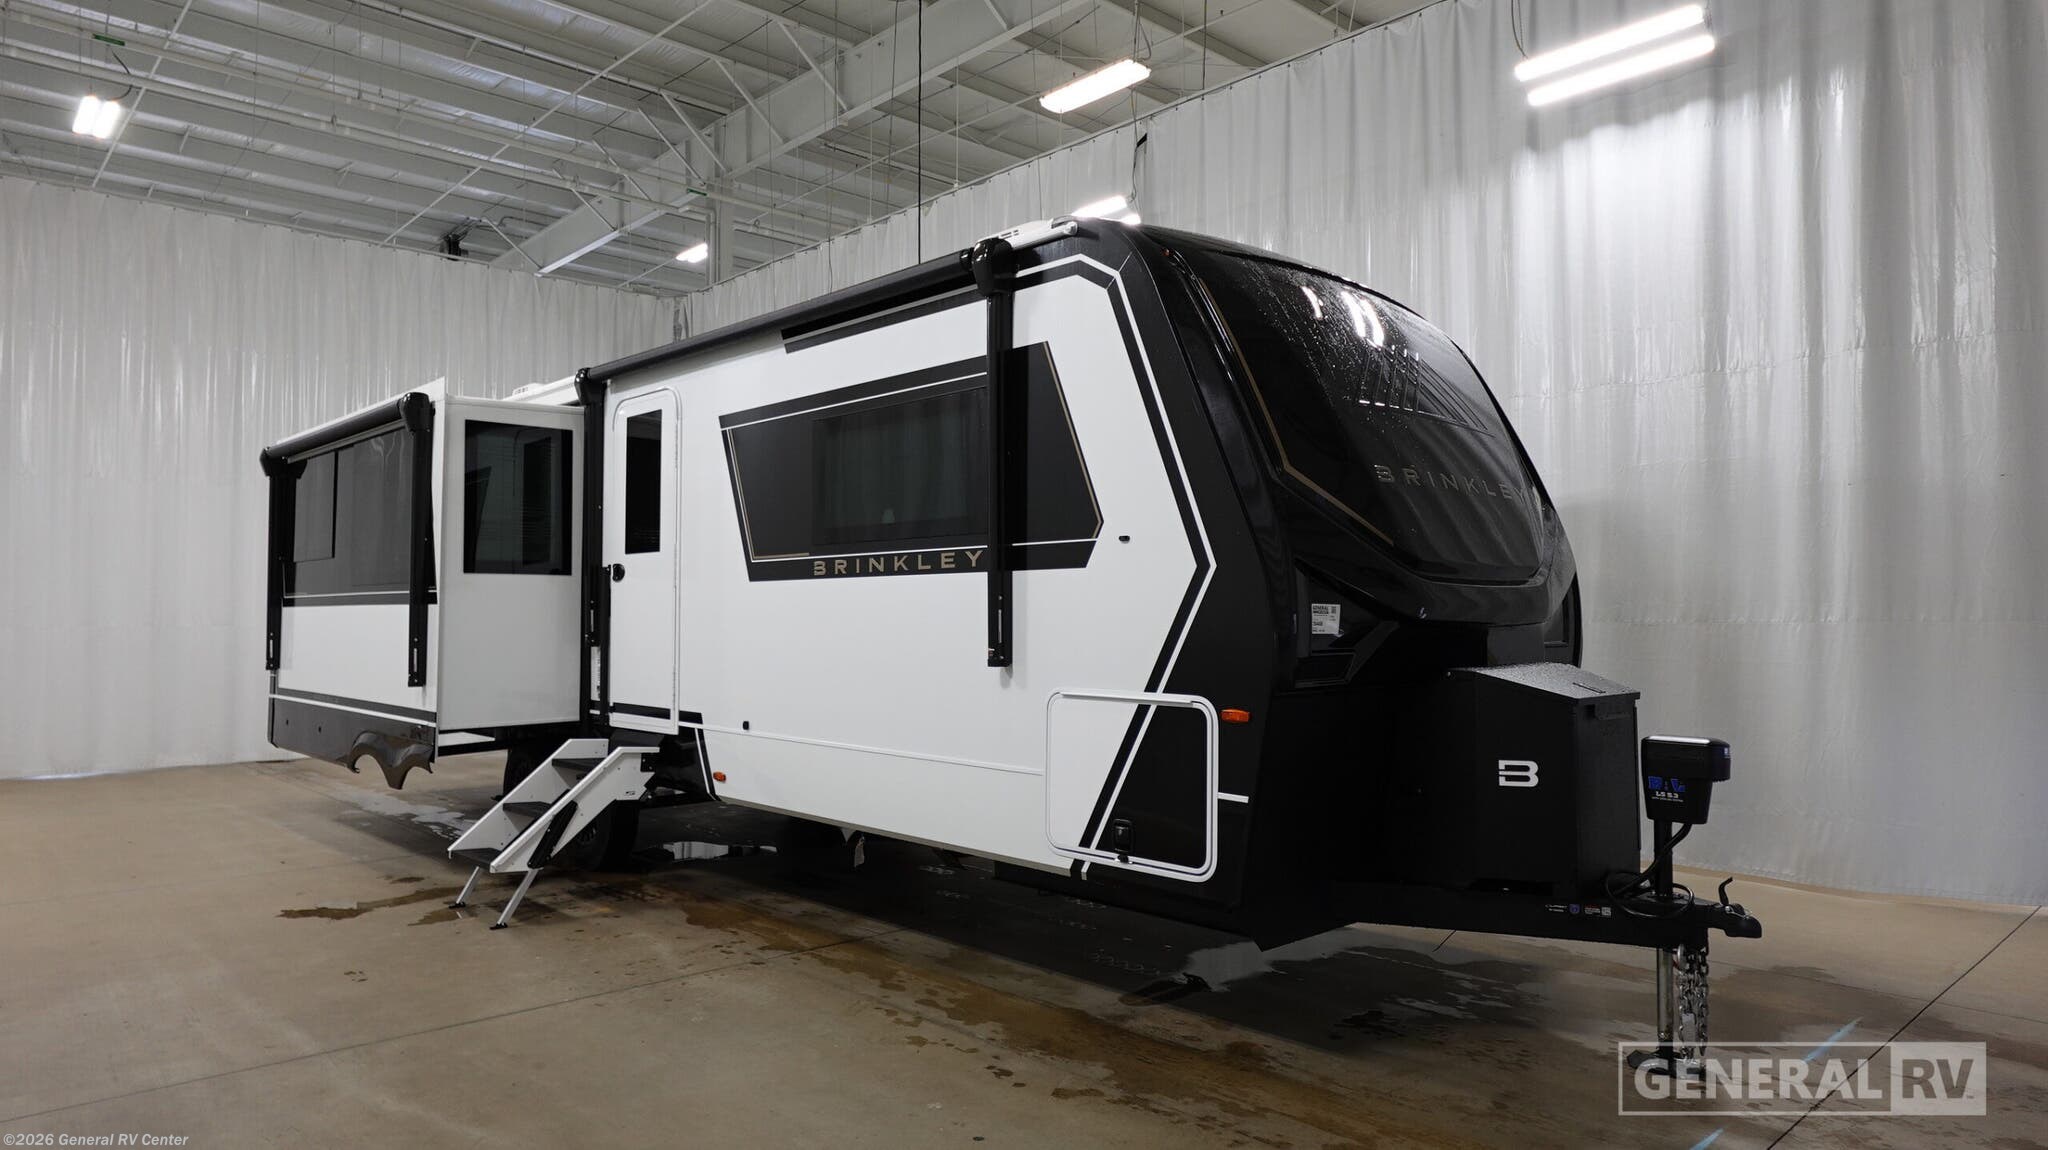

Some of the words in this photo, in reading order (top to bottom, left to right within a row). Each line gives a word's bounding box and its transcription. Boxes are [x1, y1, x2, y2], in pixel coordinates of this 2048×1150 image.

[1374, 464, 1526, 500] BRINKLEY
[813, 550, 983, 576] BRINKLEY
[1499, 760, 1538, 787] B
